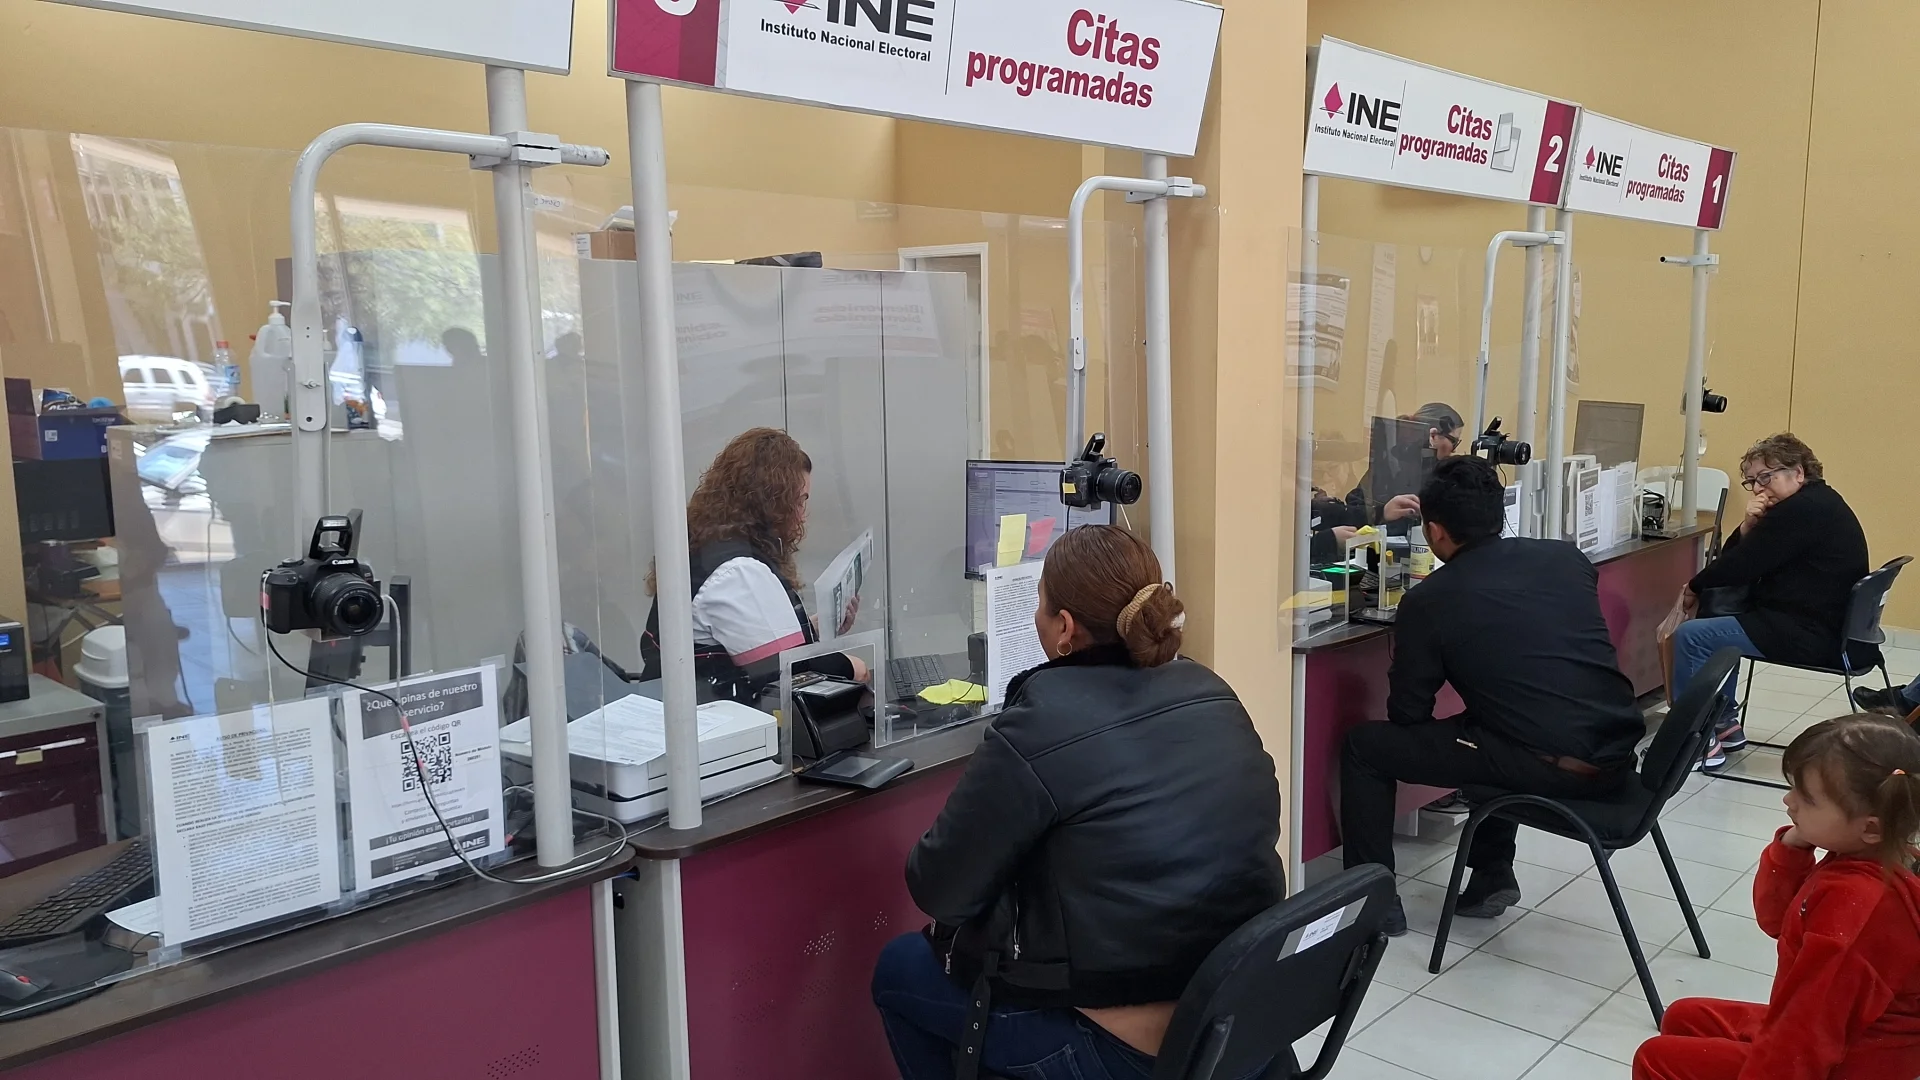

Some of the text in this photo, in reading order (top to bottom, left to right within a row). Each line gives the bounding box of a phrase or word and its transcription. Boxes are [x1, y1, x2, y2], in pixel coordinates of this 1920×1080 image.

[826, 0, 936, 42] INE
[760, 18, 932, 62] Instituto Nacional Electoral
[1067, 9, 1161, 70] Citas
[965, 51, 1154, 108] programadas
[1346, 92, 1401, 133] INE
[1447, 104, 1493, 141] Citas
[1314, 123, 1396, 147] Instituto Nacional Electoral
[1398, 133, 1488, 165] programadas
[1544, 135, 1563, 173] 2
[1596, 151, 1624, 177] INE
[1657, 153, 1690, 183] Citas
[1625, 179, 1685, 203] programadas
[1711, 175, 1723, 204] 1
[428, 689, 440, 699] de
[443, 682, 478, 696] nuestro
[404, 701, 445, 718] servicio?
[420, 726, 427, 735] el
[427, 722, 450, 735] código
[451, 719, 462, 728] QR
[425, 826, 434, 834] es
[462, 836, 487, 849] INE
